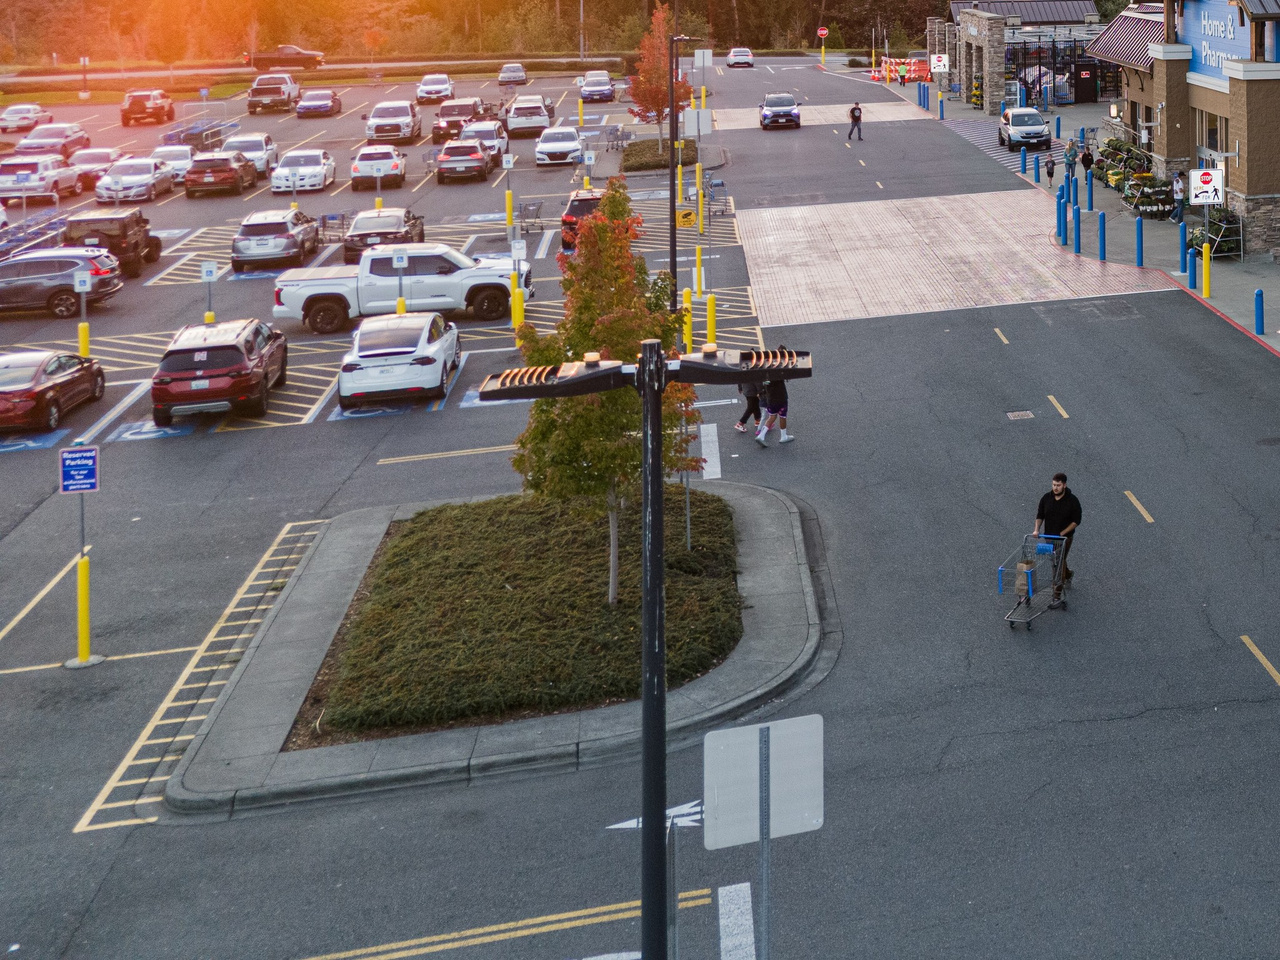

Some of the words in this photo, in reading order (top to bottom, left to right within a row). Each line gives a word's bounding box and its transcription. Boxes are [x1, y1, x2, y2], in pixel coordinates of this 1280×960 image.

[1201, 11, 1226, 38] Home
[1227, 14, 1235, 40] &
[1201, 41, 1242, 69] Pharm
